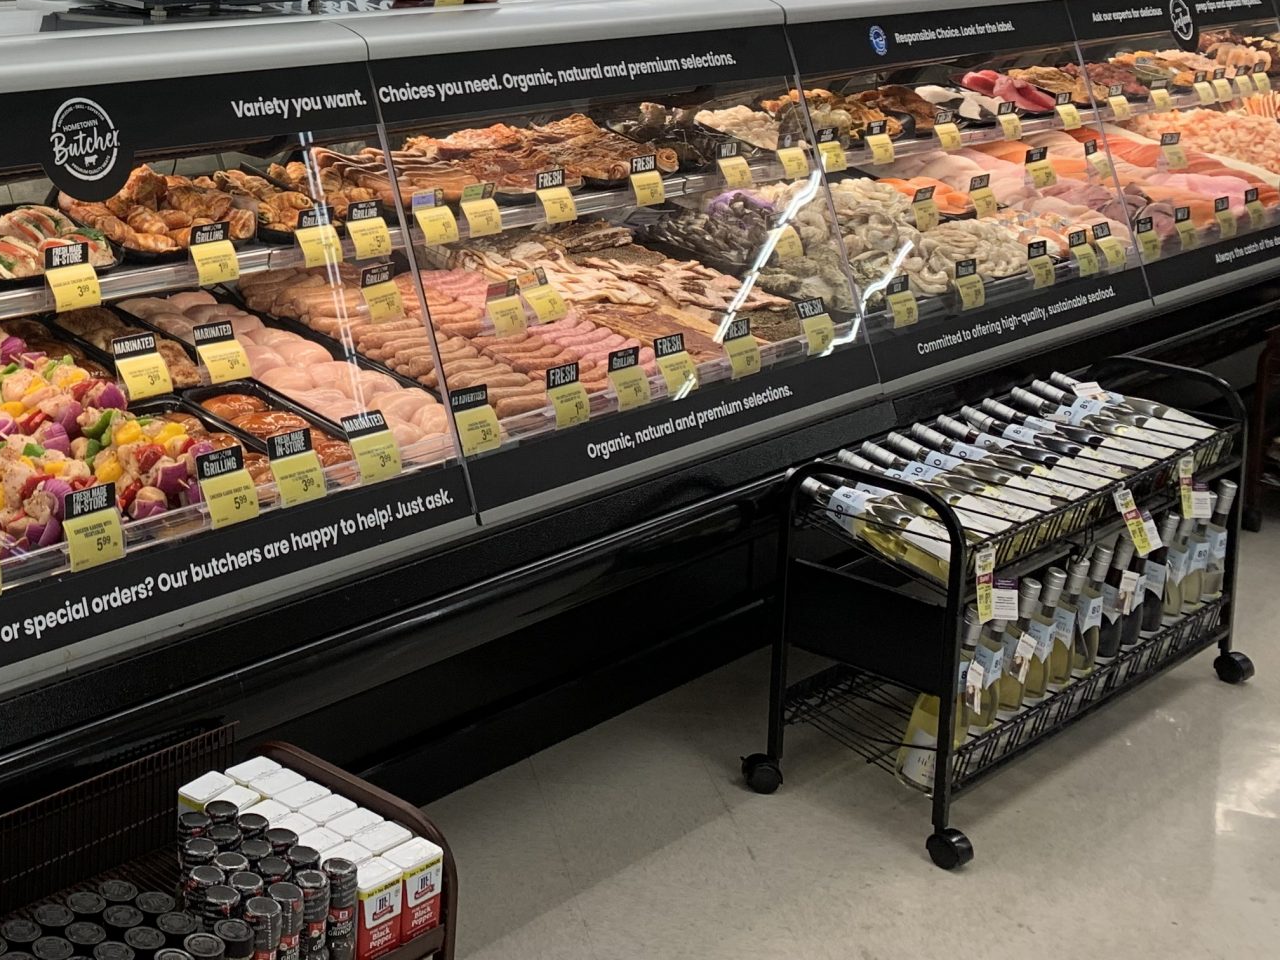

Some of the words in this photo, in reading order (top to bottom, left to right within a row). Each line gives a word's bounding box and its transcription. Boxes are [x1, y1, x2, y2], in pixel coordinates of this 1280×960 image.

[1092, 12, 1103, 23] Ask
[1104, 12, 1112, 21] our
[1112, 10, 1131, 23] experts
[1132, 8, 1140, 18] for
[1140, 7, 1163, 18] delicious
[894, 29, 936, 46] Responsible
[936, 26, 961, 39] Choice.
[960, 24, 976, 37] Look
[976, 23, 986, 35] for
[986, 22, 997, 34] the
[996, 20, 1016, 32] label.
[378, 80, 436, 103] Choices
[436, 78, 464, 102] you
[464, 74, 502, 93] need.
[502, 68, 557, 92] Organic,
[558, 64, 603, 84] natural
[604, 61, 628, 78] and
[628, 56, 680, 80] premium
[681, 51, 737, 69] selections.
[231, 96, 290, 119] Variety
[292, 95, 322, 117] you
[323, 89, 367, 109] want.
[62, 119, 98, 132] HOMETOWN
[50, 126, 118, 166] Butcher
[633, 157, 655, 172] FRESH
[52, 252, 82, 266] IN-STORE
[918, 333, 962, 355] Committed
[962, 330, 971, 340] to
[972, 321, 1001, 338] offering
[1000, 306, 1048, 331] high-quality,
[1048, 295, 1087, 315] sustainable
[1088, 286, 1116, 303] seafood.
[194, 326, 231, 340] MARINATED
[114, 336, 154, 355] MARINATED
[657, 339, 683, 355] FRESH
[550, 365, 576, 386] FRESH
[342, 414, 384, 432] MARINATED
[587, 432, 636, 460] Organic,
[636, 418, 674, 444] natural
[675, 412, 696, 431] and
[696, 398, 743, 429] premium
[744, 384, 793, 410] selections.
[204, 456, 237, 477] GRILLING
[72, 490, 91, 502] FRESH
[92, 486, 107, 498] MADE
[74, 495, 108, 515] IN-STORE
[0, 622, 20, 641] or
[23, 600, 89, 639] special
[92, 576, 154, 614] orders?
[158, 568, 188, 593] Our
[190, 546, 262, 583] butchers
[264, 538, 290, 560] are
[290, 522, 340, 552] happy
[340, 516, 356, 535] to
[357, 504, 394, 530] help!
[395, 495, 424, 520] Just
[426, 488, 454, 511] ask.
[412, 912, 433, 927] Pepper
[414, 906, 431, 918] Black
